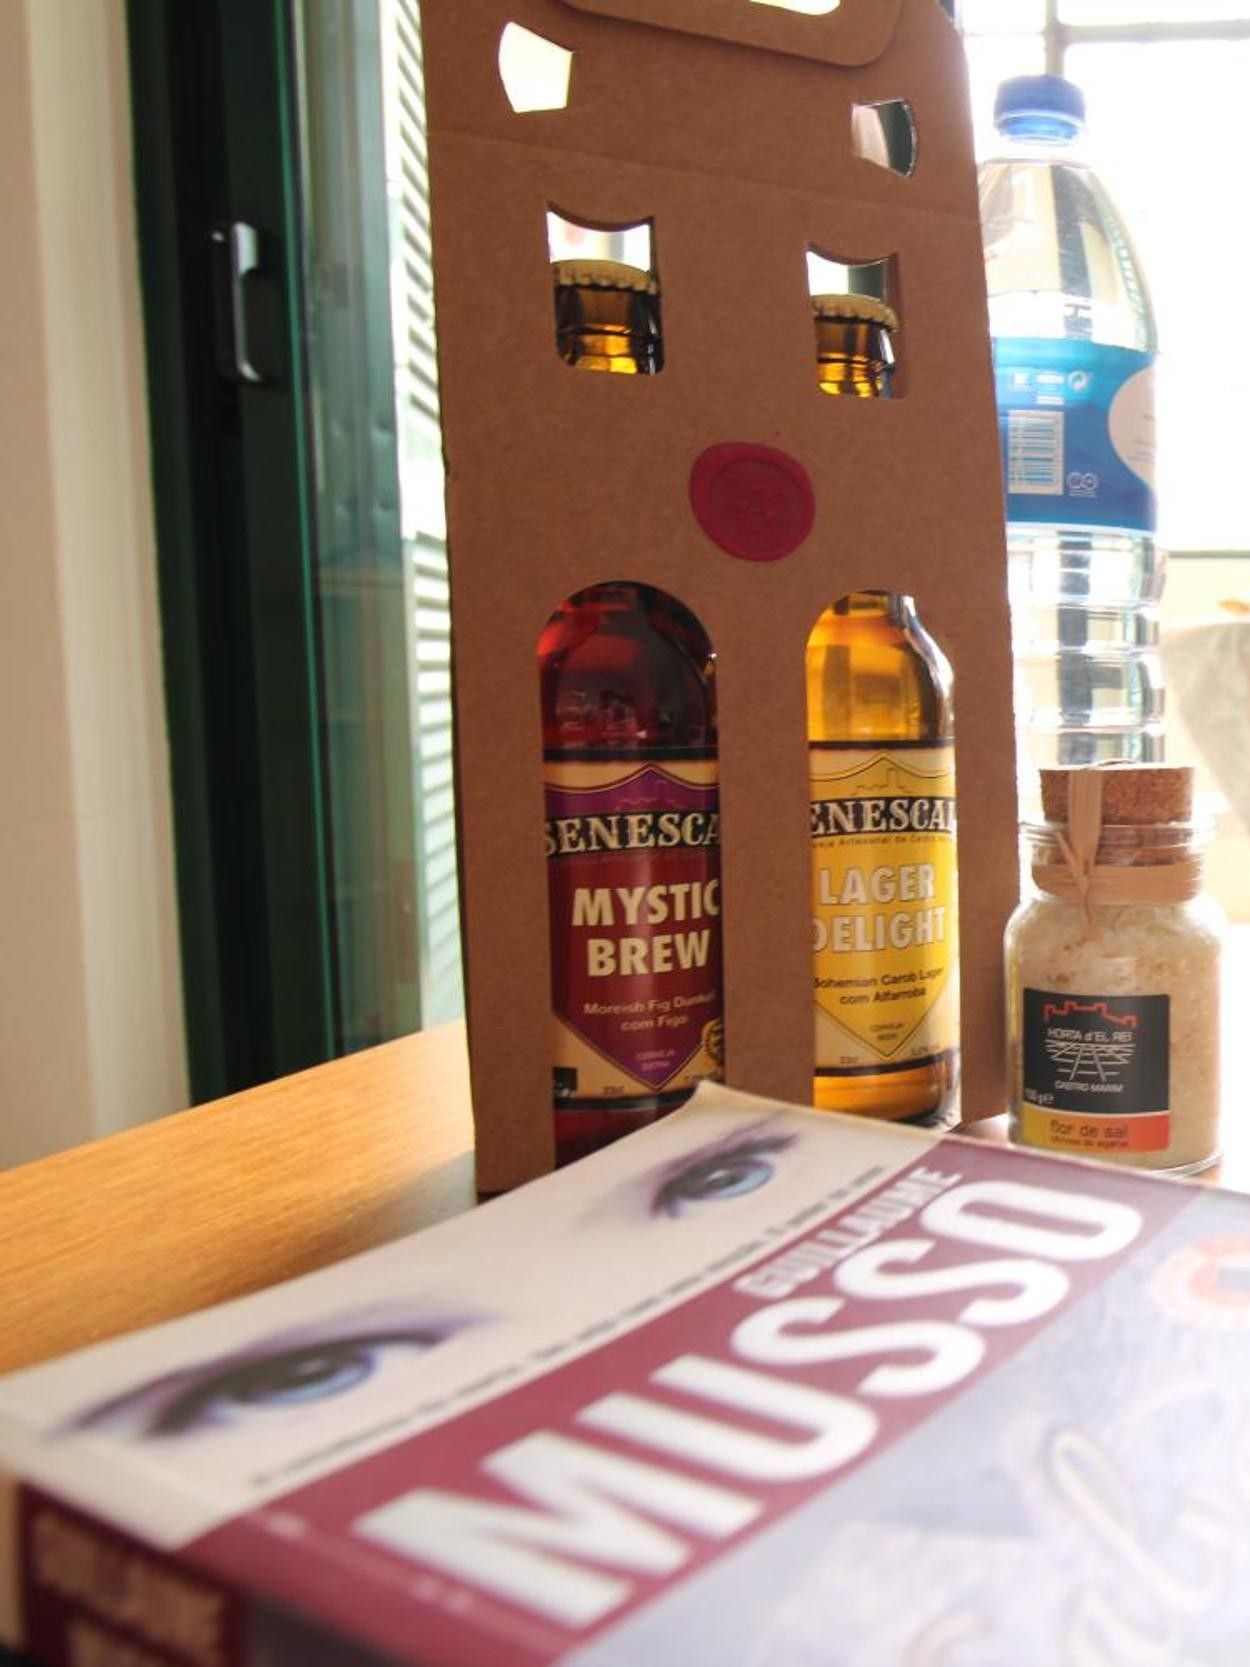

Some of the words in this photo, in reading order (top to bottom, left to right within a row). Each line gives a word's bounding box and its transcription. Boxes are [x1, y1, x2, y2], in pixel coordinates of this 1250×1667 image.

[819, 864, 935, 905] LAGER
[571, 879, 719, 926] MYSTIC
[587, 929, 710, 977] BREW
[881, 973, 917, 986] Carob
[840, 995, 869, 1005] com
[873, 987, 927, 1002] Alfarroba
[649, 1000, 671, 1013] Fig
[620, 1020, 653, 1031] com
[657, 1016, 688, 1030] Figo
[1047, 1027, 1082, 1041] HORTA
[1113, 1031, 1133, 1042] REI
[1055, 1080, 1088, 1092] CASTRO
[1051, 1119, 1073, 1134] flor
[1080, 1122, 1098, 1137] de
[1104, 1125, 1129, 1138] sal
[733, 1166, 962, 1298] GUILLAUME
[350, 1180, 1143, 1629] MUSSO
